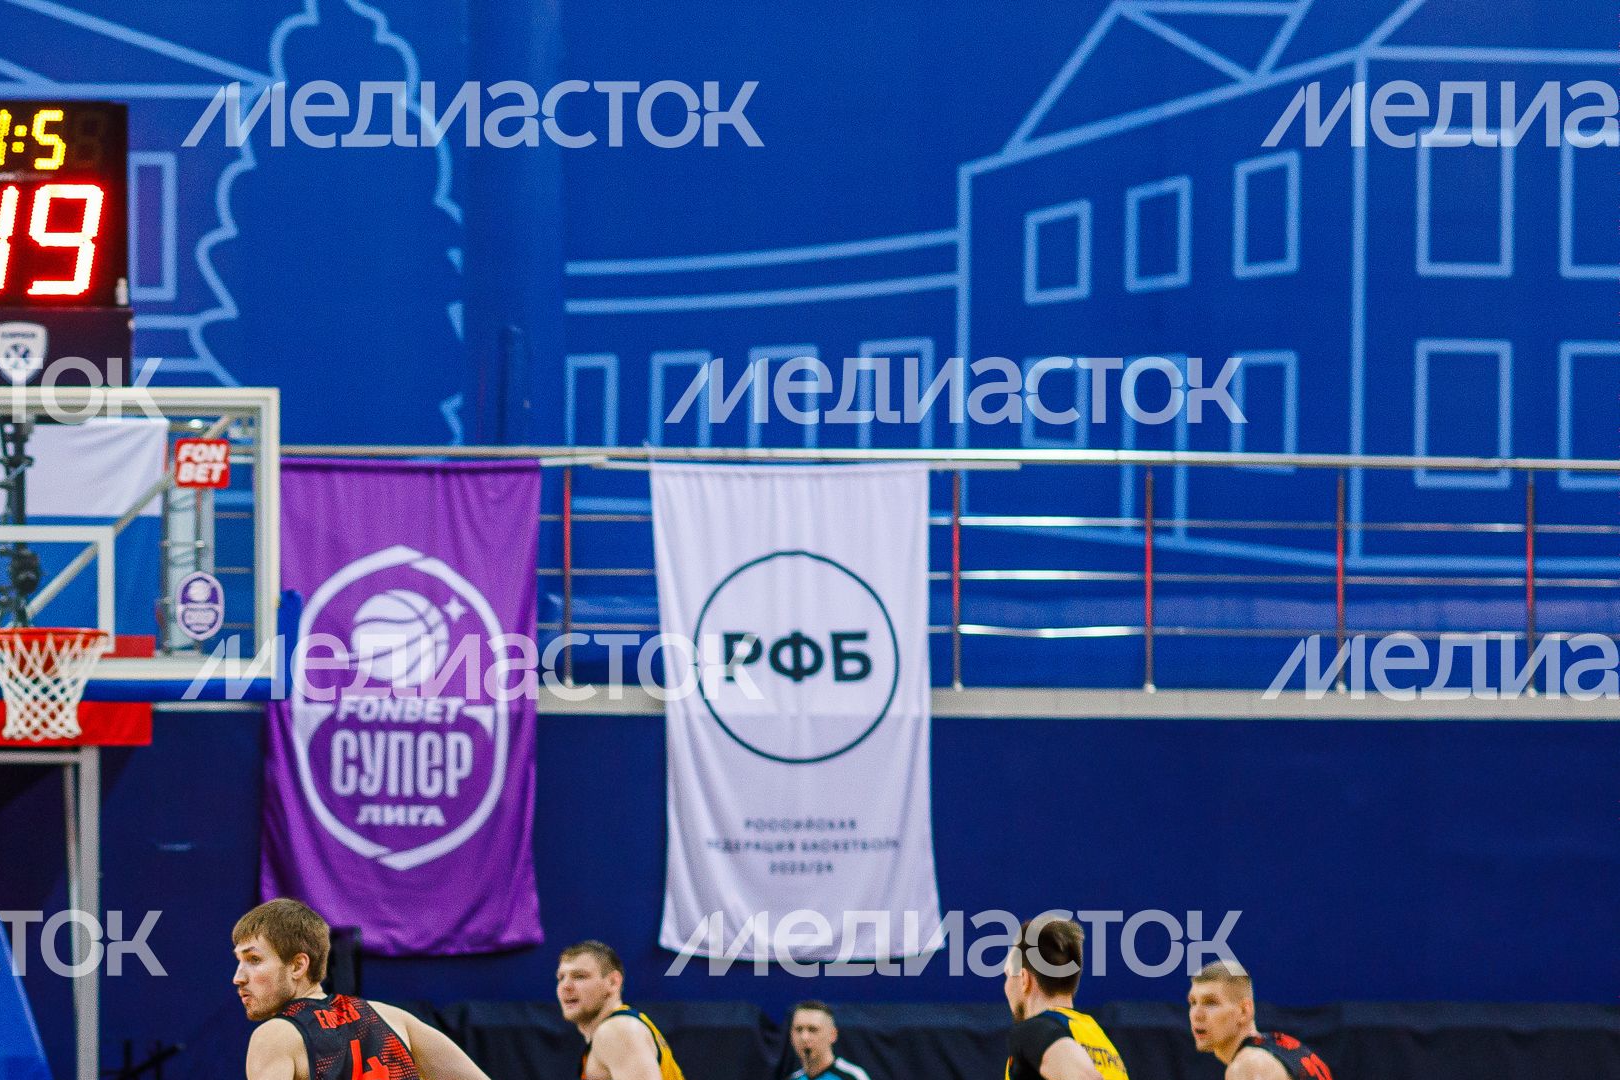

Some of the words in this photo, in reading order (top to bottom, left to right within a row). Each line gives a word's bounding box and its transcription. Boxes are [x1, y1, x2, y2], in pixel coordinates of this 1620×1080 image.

[178, 443, 227, 462] FON
[179, 462, 227, 482] BET
[723, 630, 873, 682] РФБ
[336, 695, 468, 723] FONBET
[357, 804, 446, 826] ЛИГА
